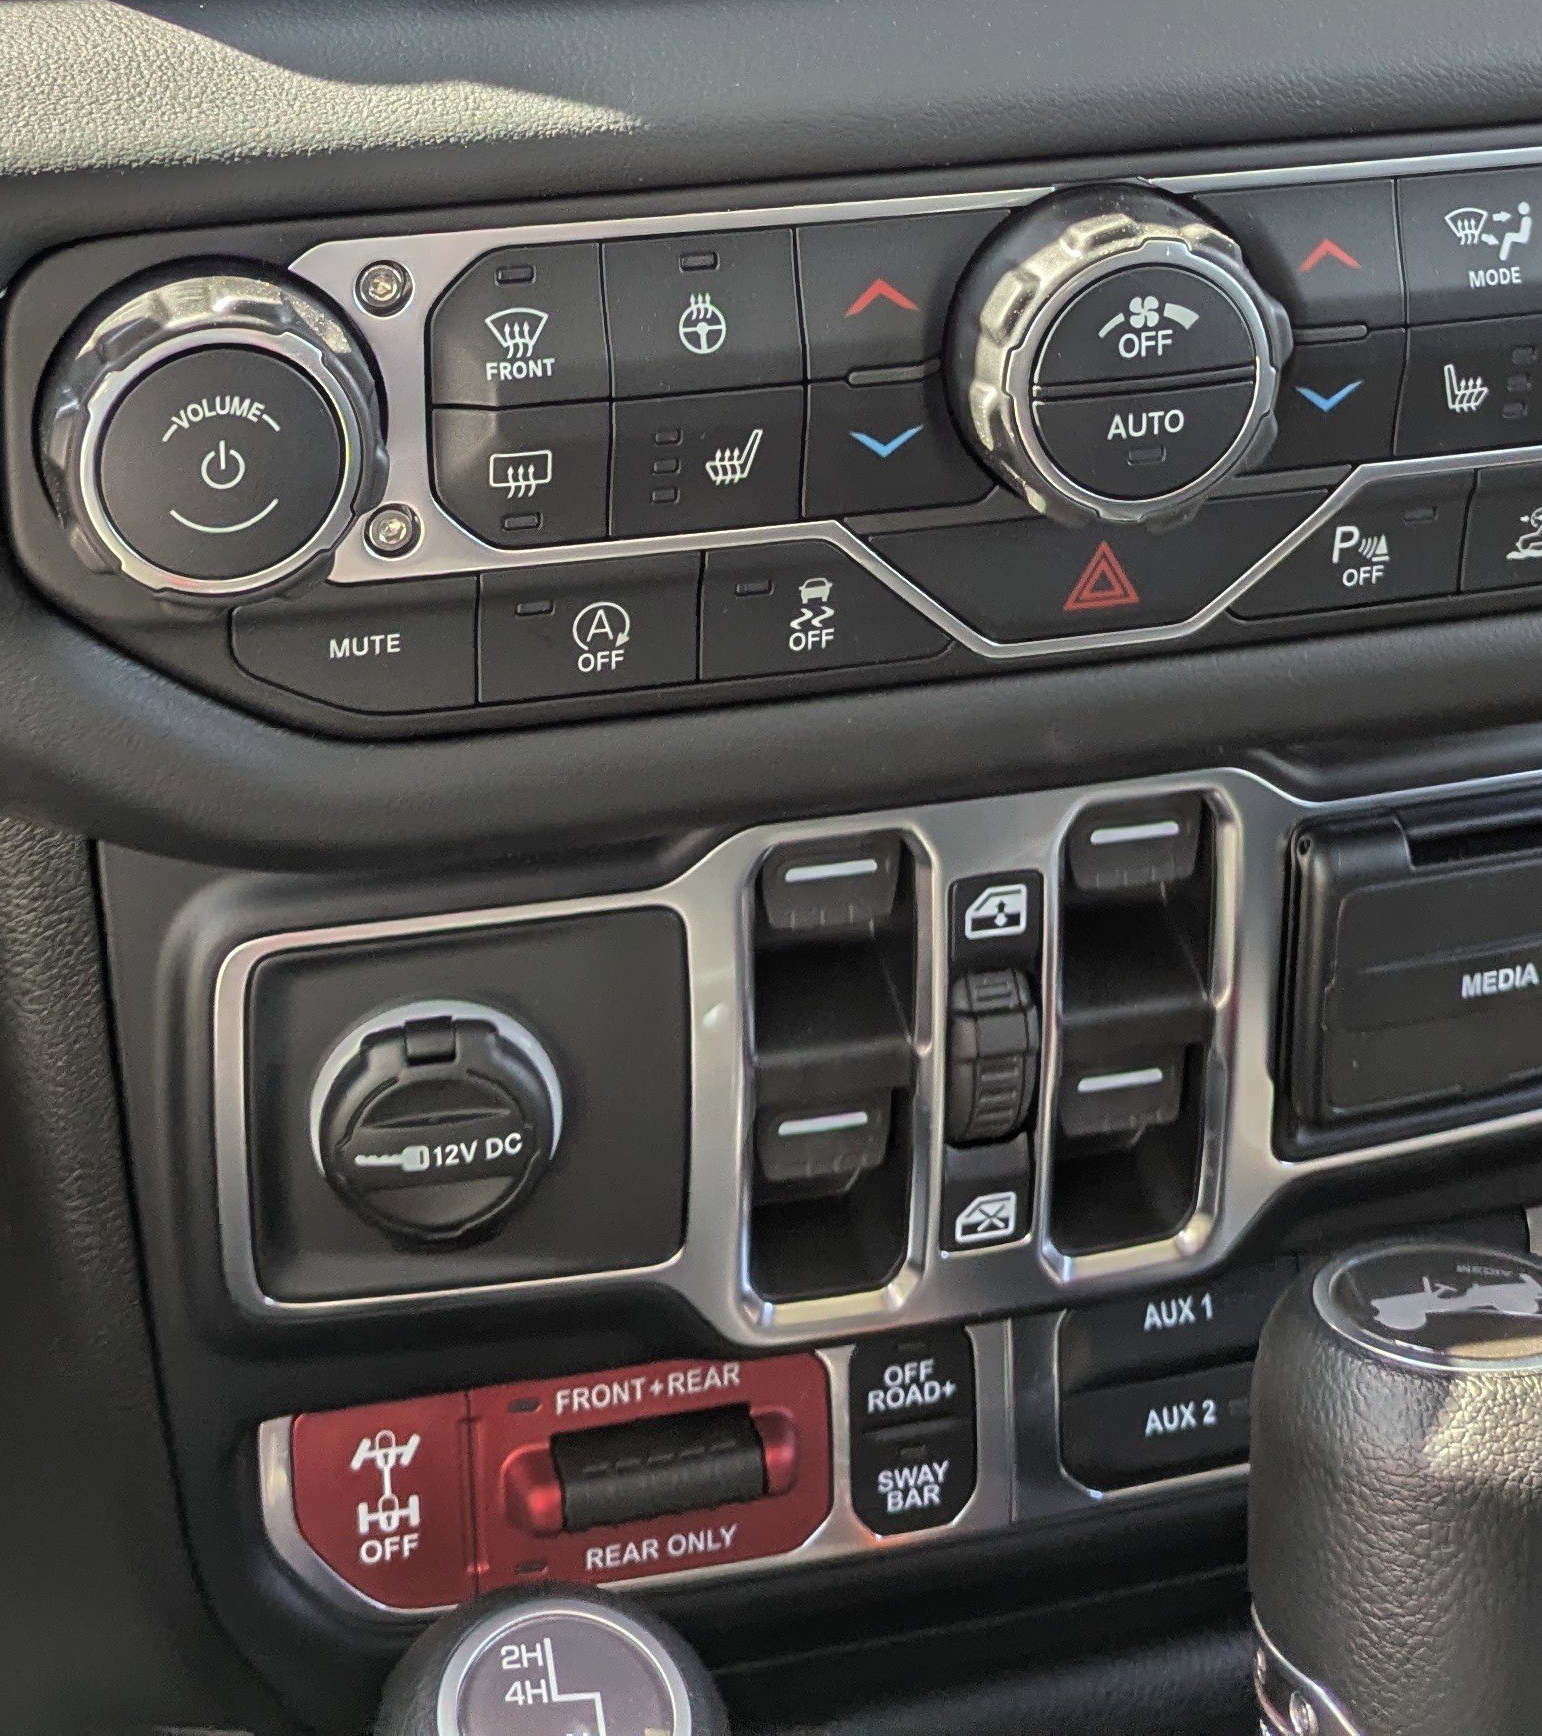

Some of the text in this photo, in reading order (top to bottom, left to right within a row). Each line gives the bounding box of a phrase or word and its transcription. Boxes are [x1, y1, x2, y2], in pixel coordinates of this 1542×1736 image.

[1468, 266, 1522, 289] MODE
[1118, 330, 1173, 358] OFF
[486, 357, 555, 381] FRONT
[171, 395, 266, 430] VOLUME
[1107, 409, 1184, 440] AUTO
[1342, 564, 1384, 588] OFF
[329, 634, 401, 658] MUTE
[788, 629, 835, 651] OFF
[577, 649, 624, 673] OFF
[1461, 963, 1539, 998] MEDIA
[432, 1132, 523, 1167] 12V DC
[1143, 1293, 1214, 1333] AUX 1
[883, 1359, 935, 1387] OFF
[867, 1379, 956, 1415] ROAD+
[1144, 1400, 1218, 1439] AUX 2
[877, 1461, 950, 1495] SWAY
[886, 1482, 940, 1513] BAR
[360, 1533, 420, 1564] OFF
[587, 1524, 738, 1570] REAR ONLY
[500, 1642, 545, 1671] 2H
[504, 1679, 549, 1707] 4H
